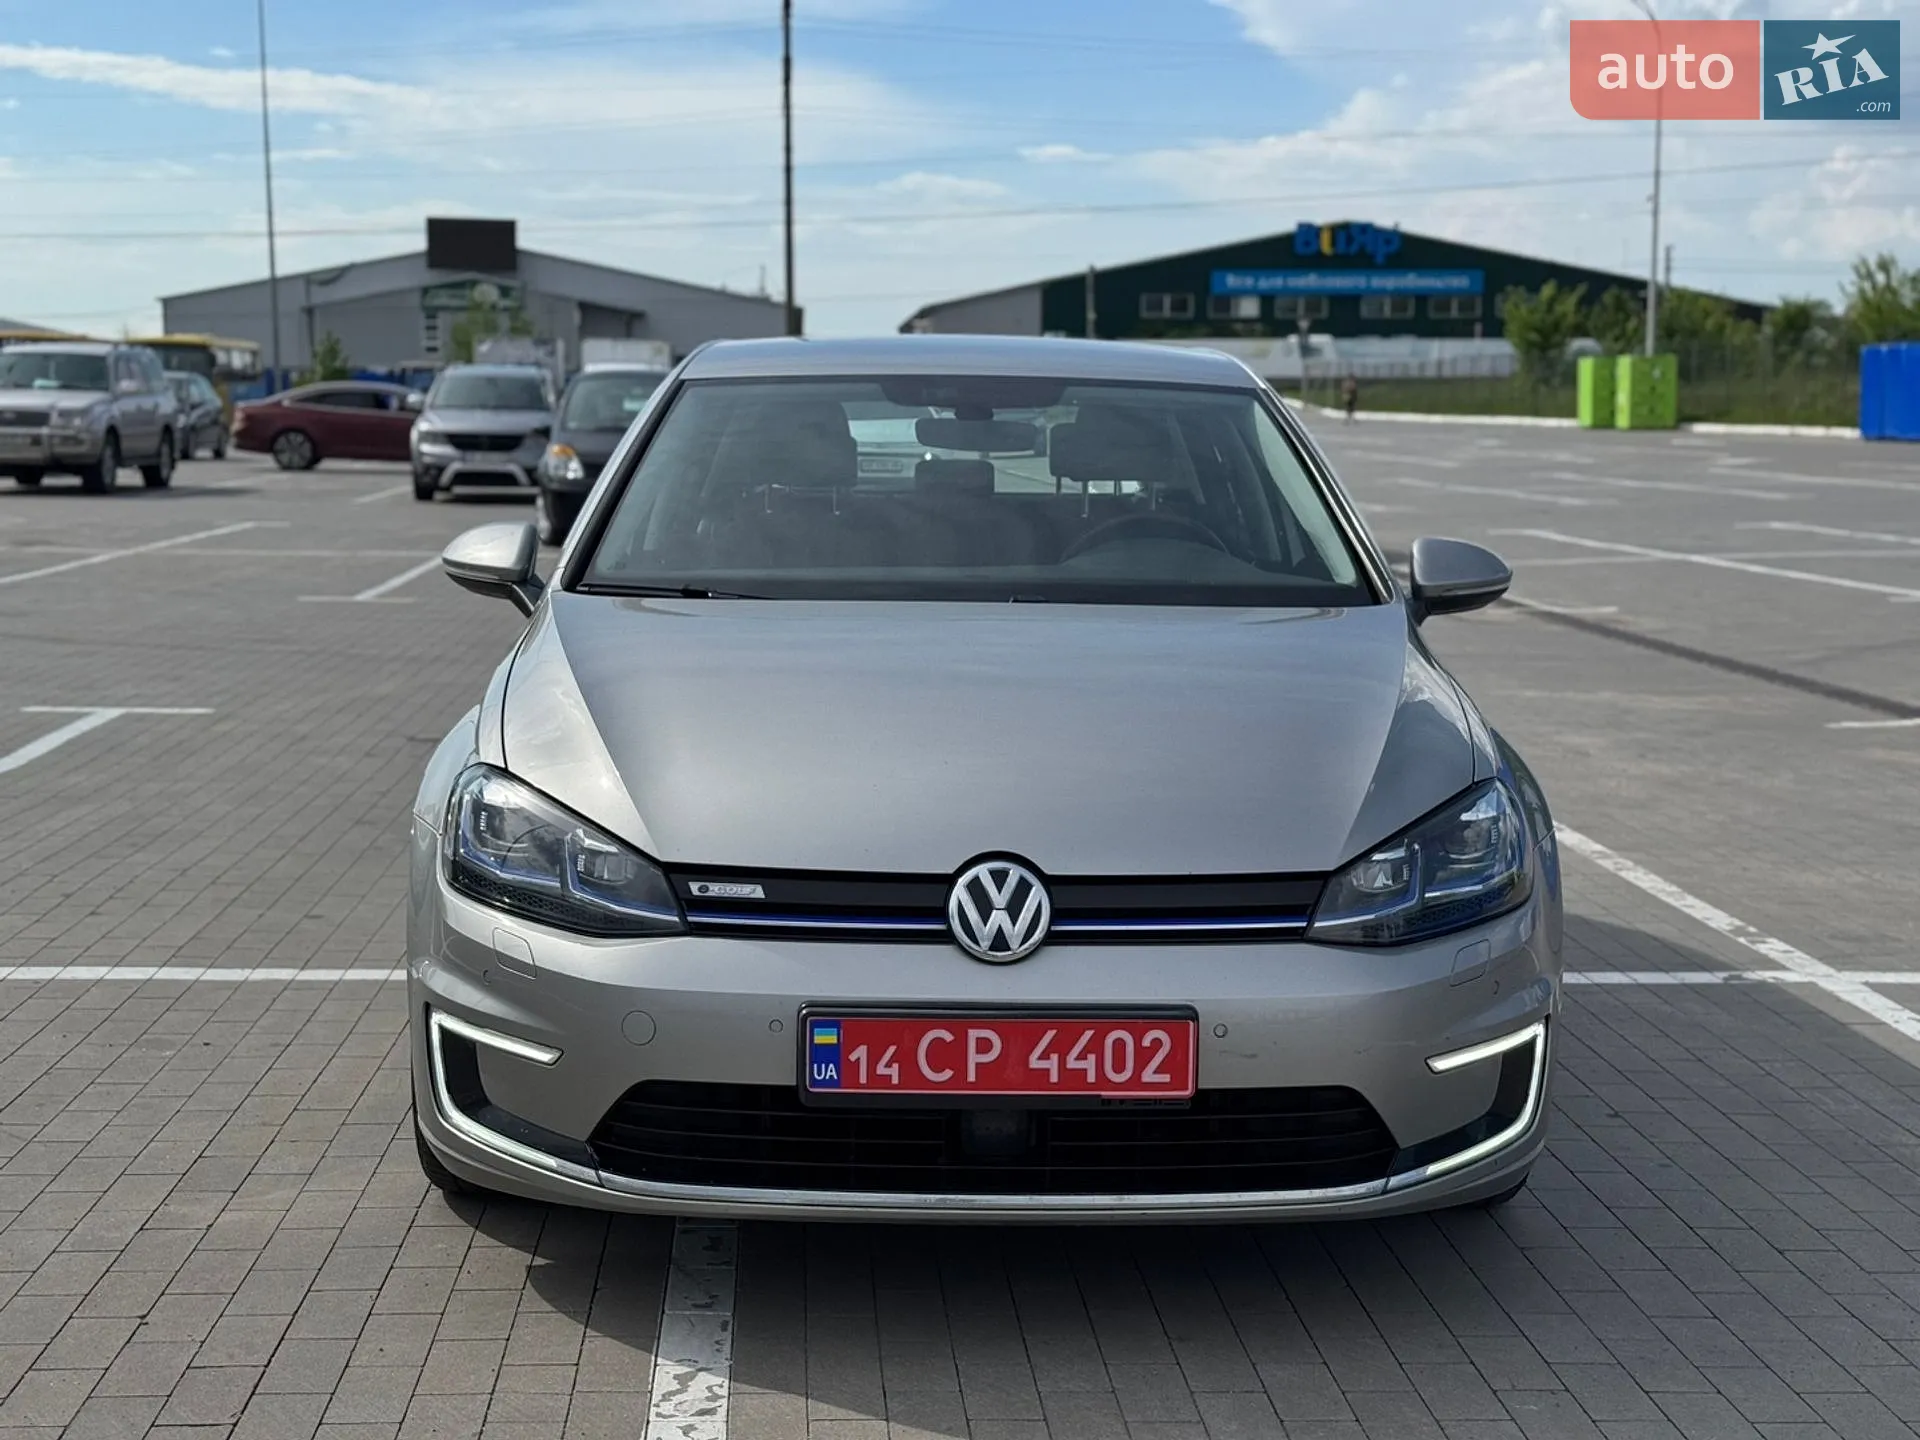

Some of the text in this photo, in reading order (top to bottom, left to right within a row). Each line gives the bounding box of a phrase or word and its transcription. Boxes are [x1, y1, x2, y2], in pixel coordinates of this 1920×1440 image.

[813, 1063, 838, 1080] UA
[848, 1028, 1173, 1084] 14 CP 4402
